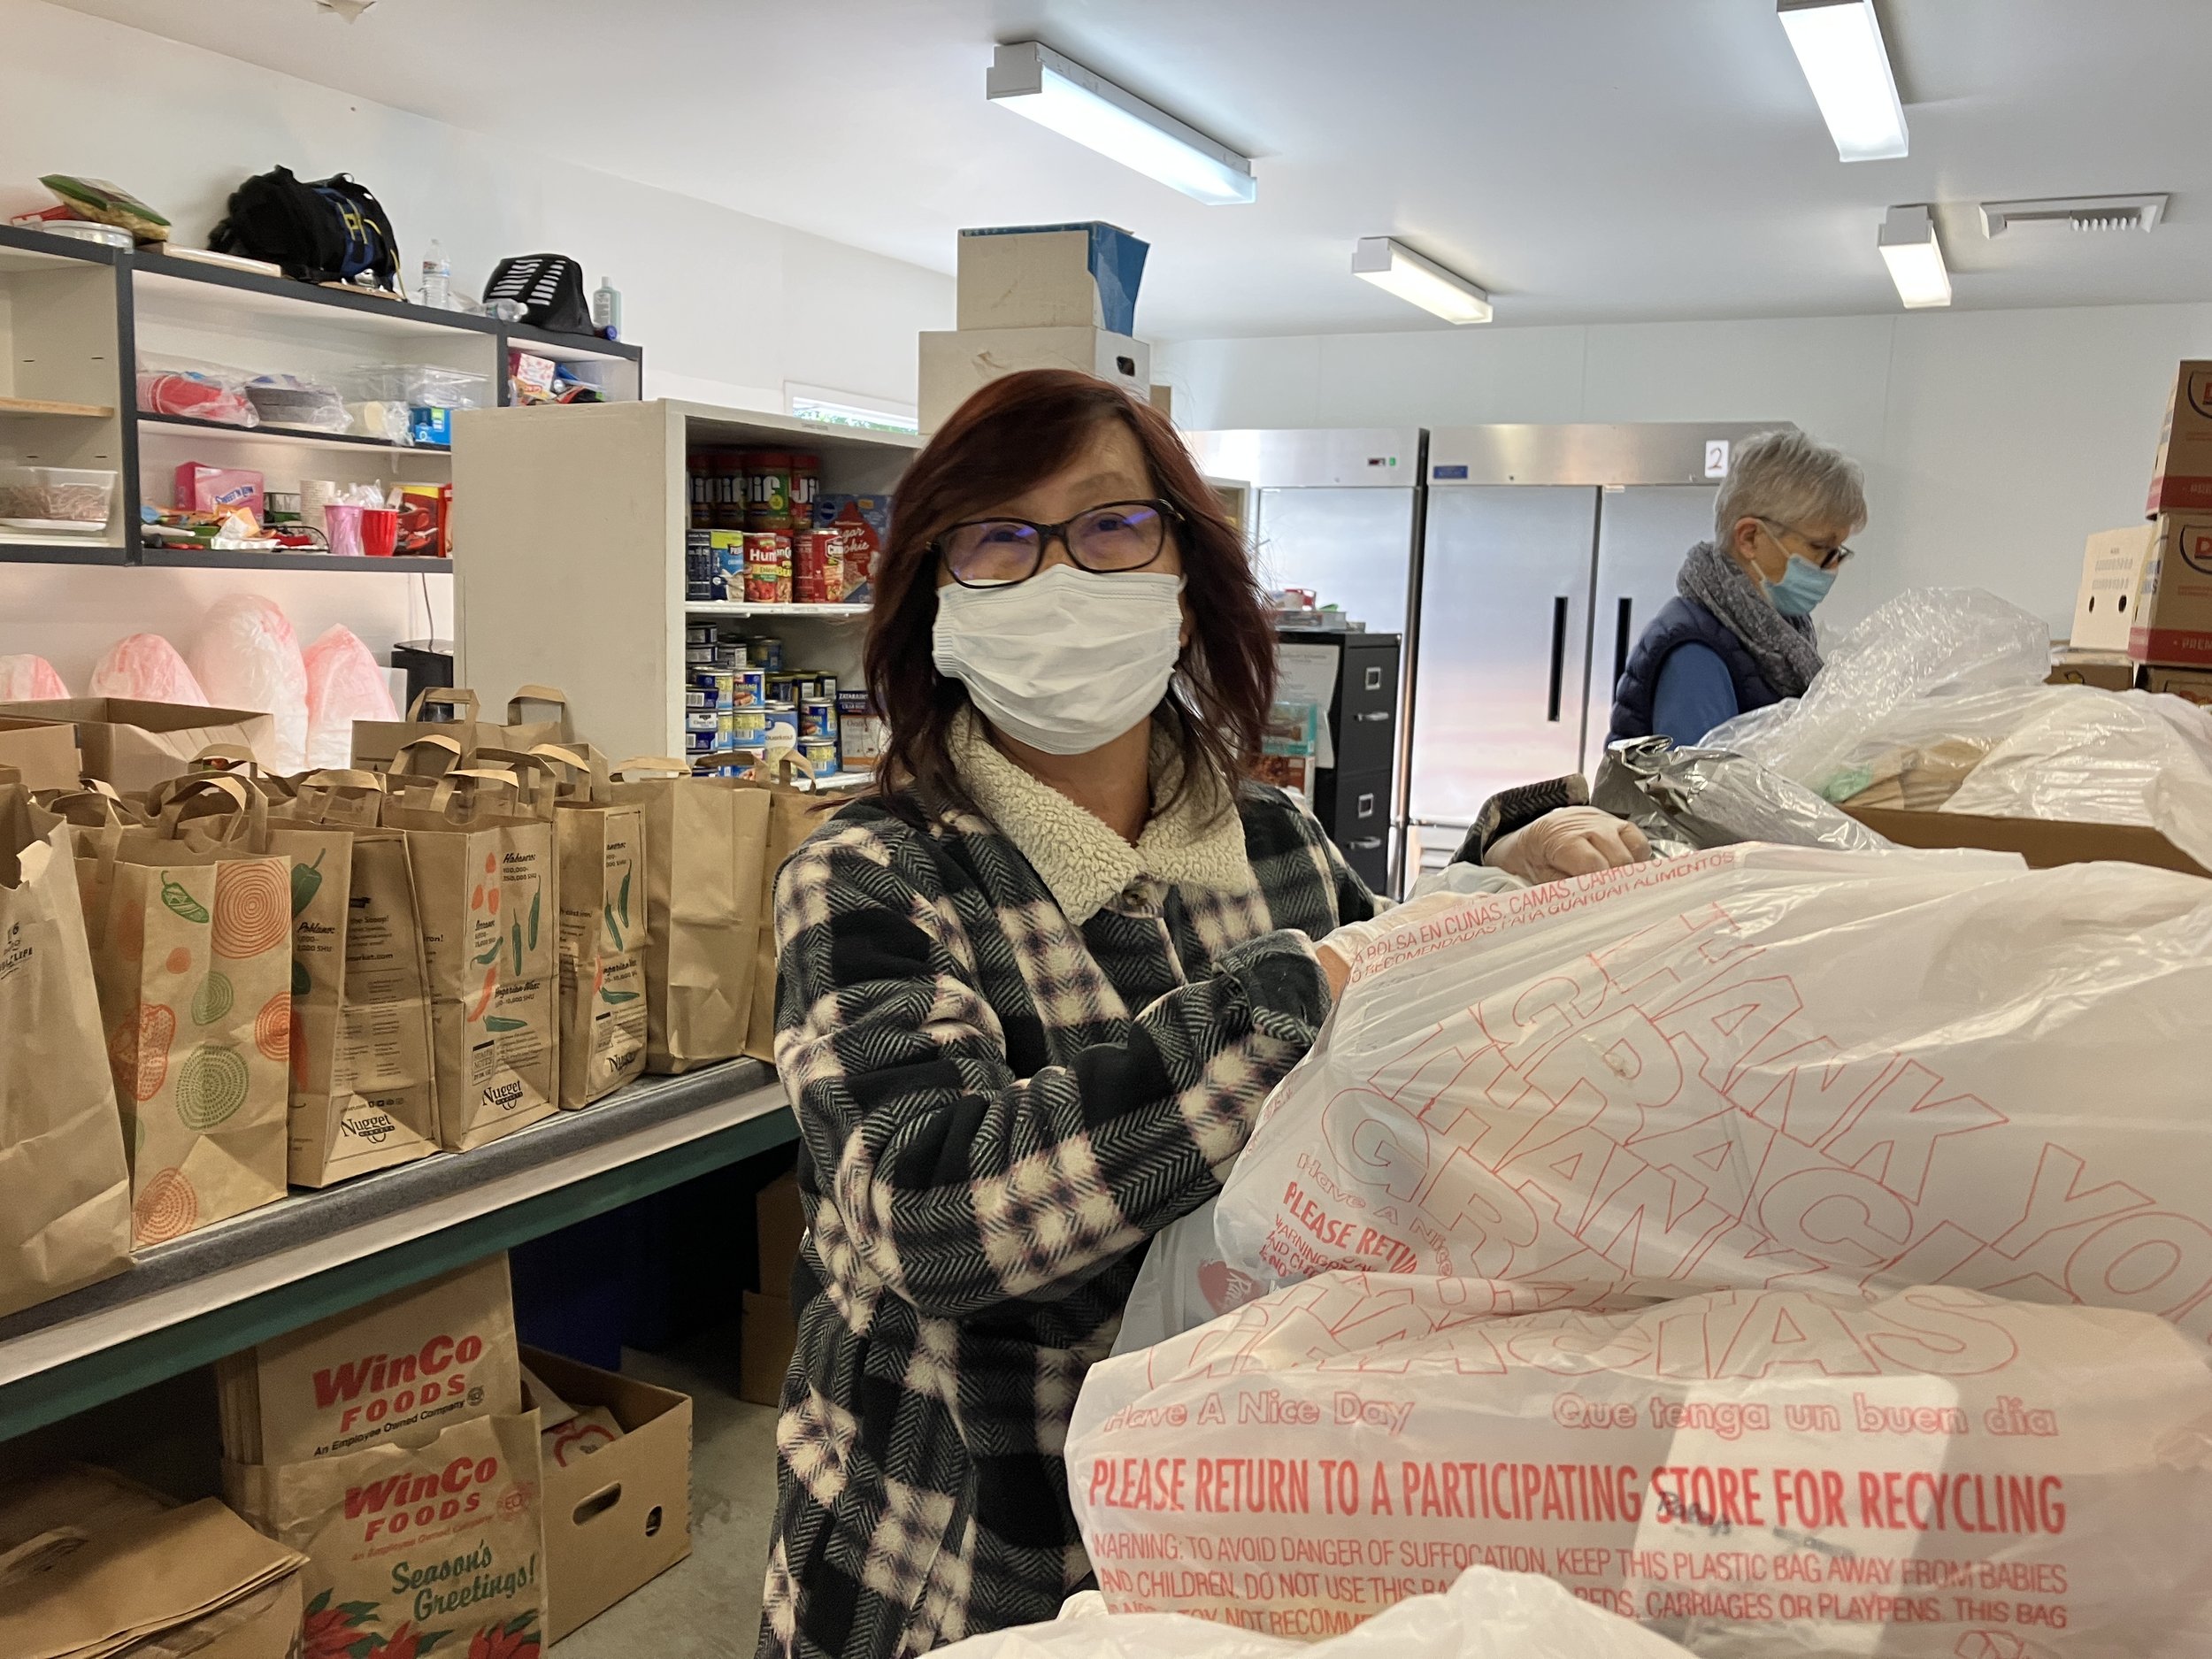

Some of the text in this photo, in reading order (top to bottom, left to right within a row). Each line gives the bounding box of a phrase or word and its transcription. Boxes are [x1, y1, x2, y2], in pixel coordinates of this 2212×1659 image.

[1708, 447, 1723, 471] 2
[791, 477, 819, 504] Ji
[1366, 931, 1417, 958] BOLSA
[1419, 920, 1442, 943] EN
[482, 1080, 523, 1106] Nugget
[341, 1113, 392, 1138] Nugget
[1283, 1181, 1357, 1249] PLEASE
[313, 1334, 482, 1410] WinCo
[314, 1399, 466, 1457] An Employee Owned Company
[340, 1373, 466, 1434] FOODS
[1104, 1388, 1416, 1438] Have A Nice Day
[1552, 1390, 1637, 1431] Que
[1648, 1394, 1770, 1441] tenga
[1784, 1403, 1841, 1432] un
[1853, 1392, 1970, 1436] buen
[343, 1456, 499, 1521] WinCo
[1089, 1456, 1188, 1512] PLEASE
[1194, 1457, 1310, 1515] RETURN
[1317, 1459, 1360, 1517] TO
[1371, 1459, 1394, 1517] A
[1401, 1461, 1643, 1524] PARTICIPATING
[1649, 1465, 1765, 1527] STORE
[1772, 1467, 1848, 1530] FOR
[1857, 1471, 2067, 1535] RECYCLING
[365, 1492, 480, 1543] FOODS
[390, 1538, 493, 1595] Season's
[413, 1553, 536, 1623] Greetings!
[1185, 1535, 1214, 1561] TO
[1217, 1536, 1277, 1563] AVOID
[1282, 1536, 1363, 1567] DANGER
[1367, 1540, 1395, 1567] OF
[1555, 1548, 1612, 1578] KEEP
[1615, 1548, 1669, 1582] THIS
[1672, 1551, 1768, 1583] PLASTIC
[1772, 1552, 1823, 1584] BAG
[1826, 1555, 1895, 1586] AWAY
[1901, 1557, 1975, 1591] FROM
[1979, 1561, 2069, 1594] BABIES
[1099, 1567, 1134, 1594] AND
[1243, 1572, 1275, 1601] DO
[1279, 1572, 1320, 1599] NOT
[1324, 1574, 1365, 1604] USE
[1364, 1577, 1417, 1603] THIS
[1645, 1590, 1774, 1621] CARRIAGES
[1778, 1593, 1813, 1621] OR
[1954, 1595, 2011, 1624] THIS
[2016, 1602, 2069, 1630] BAG
[1225, 1607, 1263, 1634] NOT
